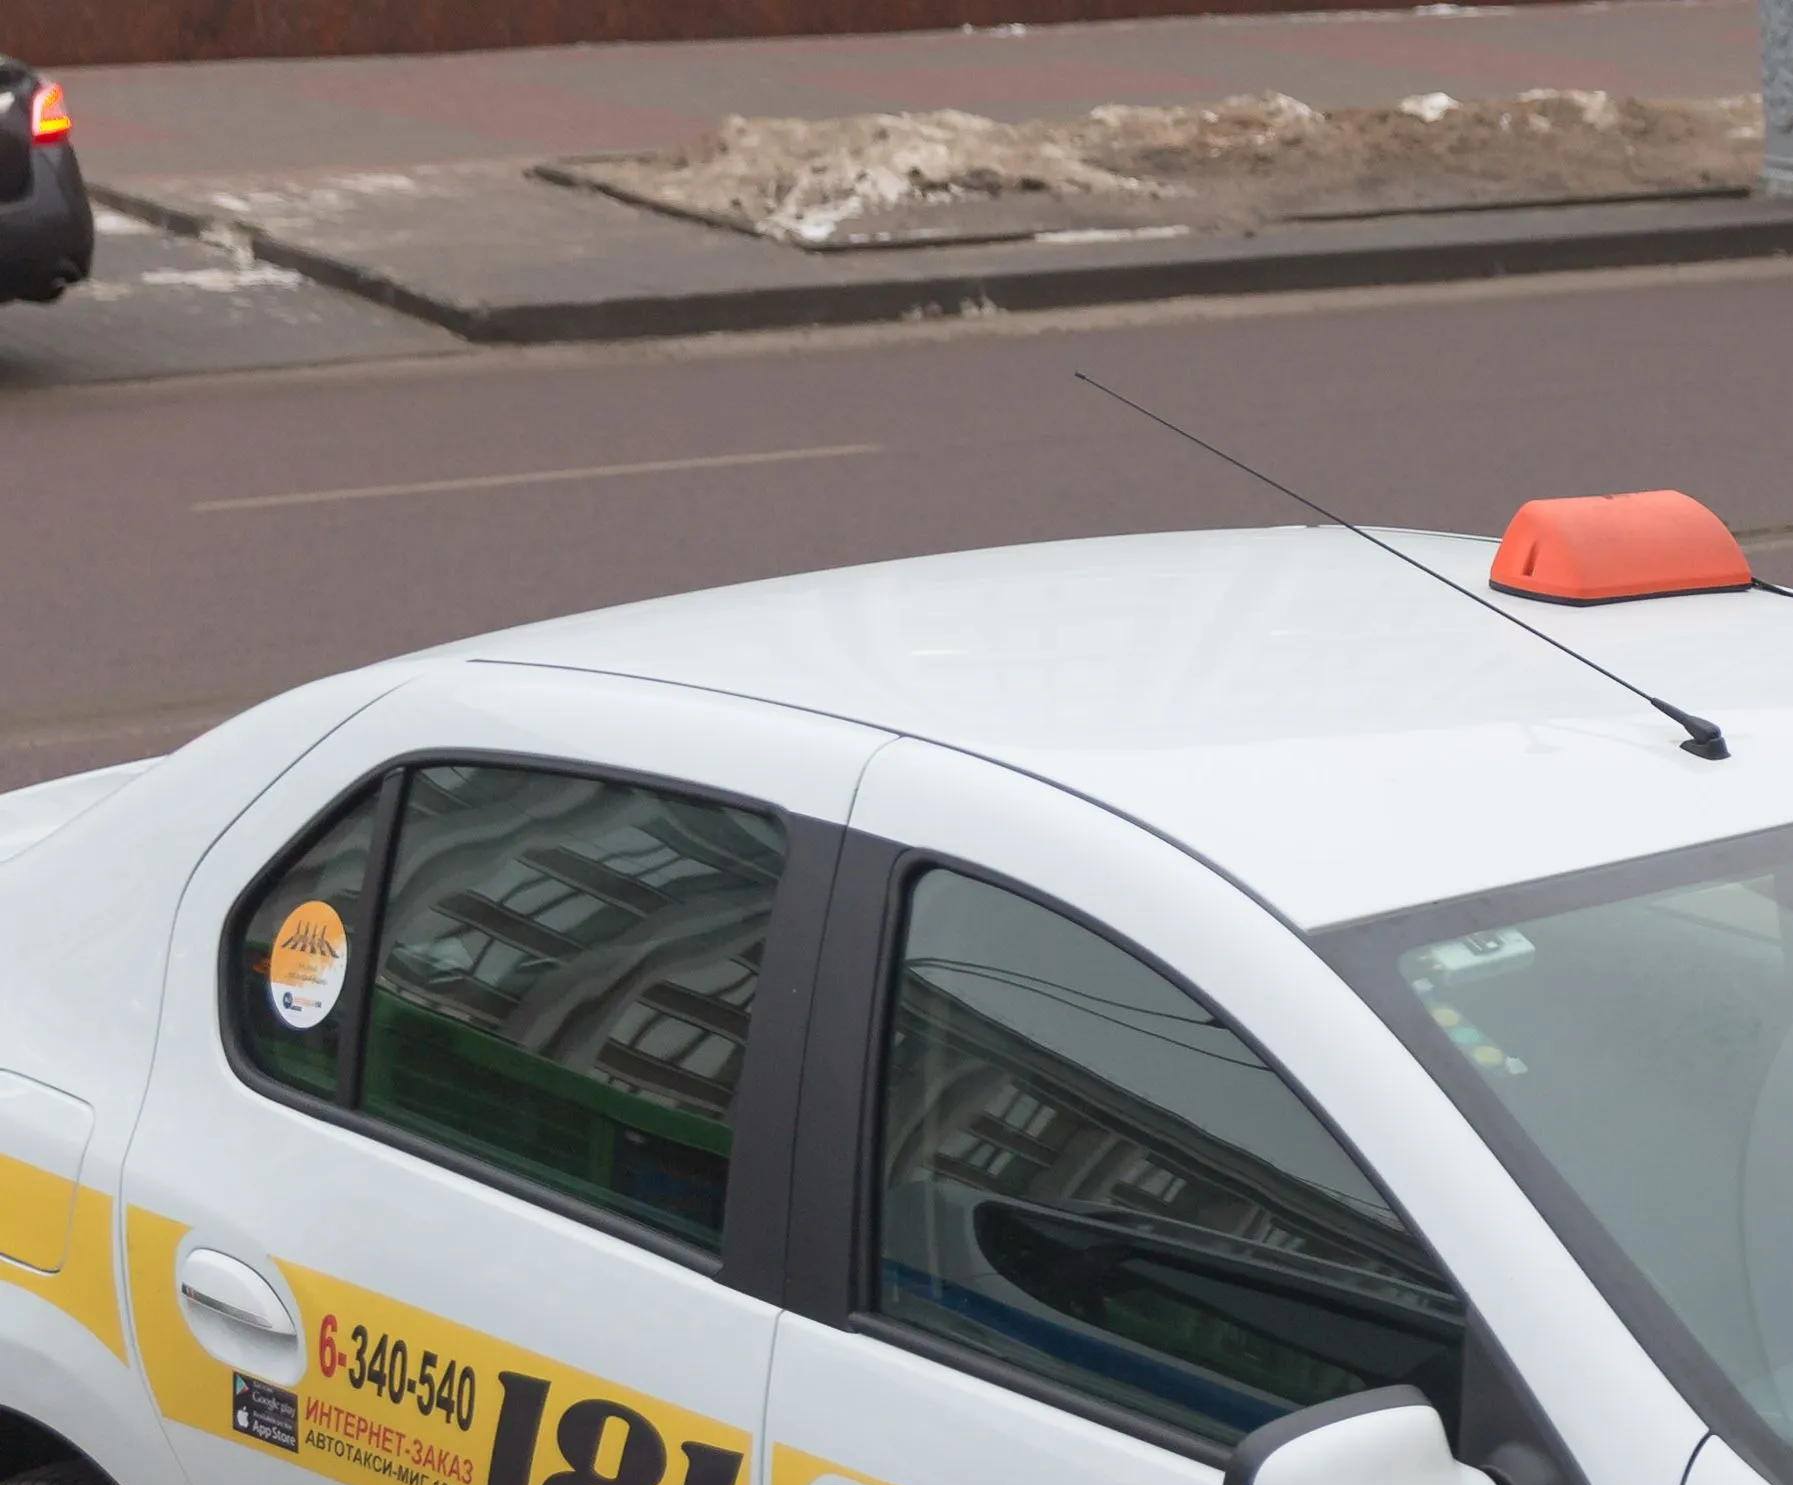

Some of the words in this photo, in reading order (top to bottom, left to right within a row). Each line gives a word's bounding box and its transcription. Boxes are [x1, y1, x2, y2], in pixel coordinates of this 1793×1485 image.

[319, 1314, 476, 1432] 6-340-540
[252, 1420, 272, 1439] App
[272, 1427, 296, 1446] Store
[305, 1396, 474, 1485] ИНТЕРНЕТ-ЗАКАЗ
